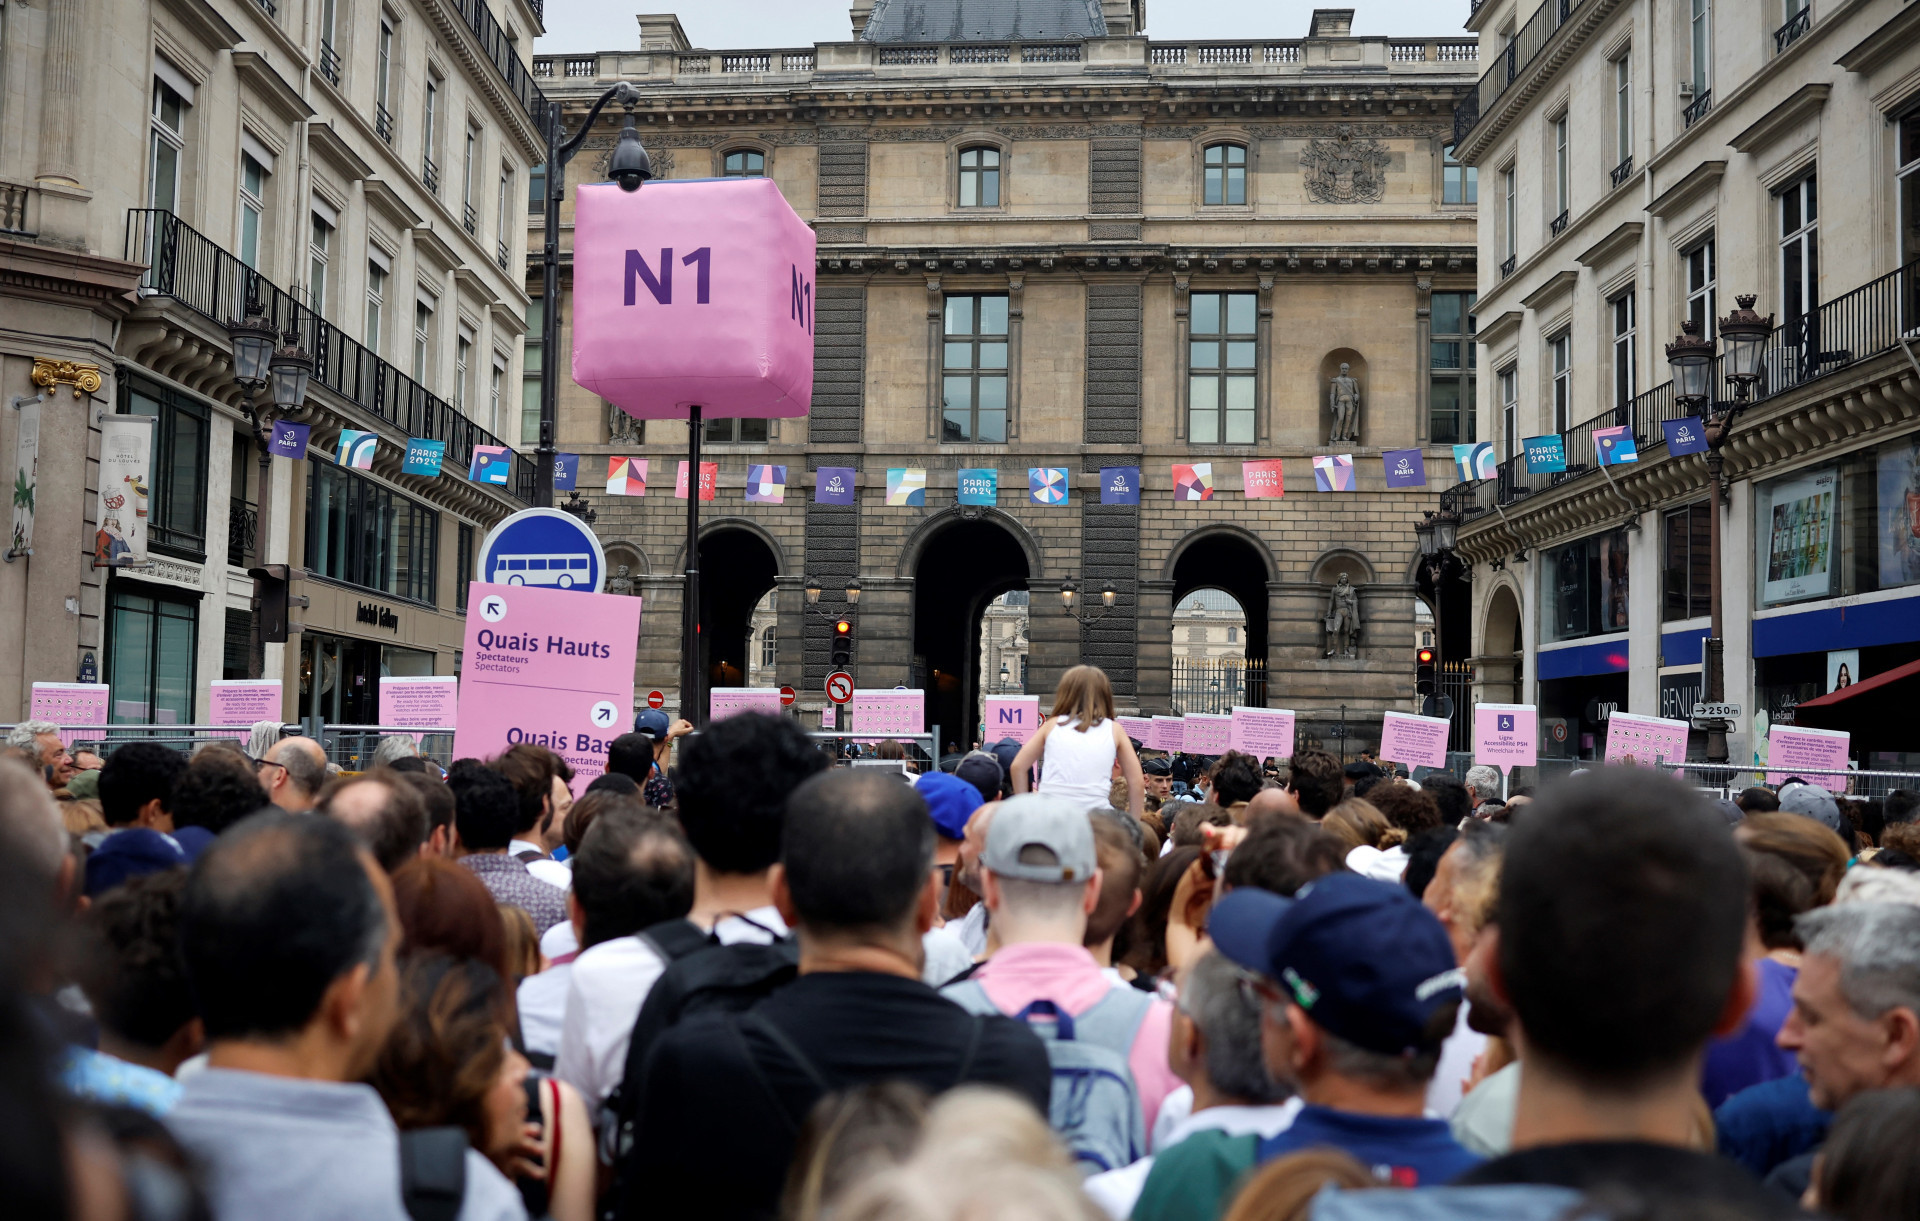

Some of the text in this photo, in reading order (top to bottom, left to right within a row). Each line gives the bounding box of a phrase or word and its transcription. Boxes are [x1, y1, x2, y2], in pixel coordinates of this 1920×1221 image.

[624, 247, 710, 306] N1
[792, 263, 811, 336] N1
[278, 439, 297, 448] PARIS
[1675, 435, 1696, 445] PARIS
[410, 448, 438, 458] PARIS
[1529, 445, 1558, 456] PARIS
[409, 456, 436, 466] 2024
[906, 458, 965, 469] PAVILLON
[1531, 455, 1559, 464] 2024
[1248, 470, 1277, 479] PARIS
[1394, 467, 1415, 476] PARIS
[682, 480, 710, 489] 224
[963, 478, 991, 487] PARIS
[1249, 479, 1278, 487] 2024
[1816, 475, 1833, 485] sisley
[963, 487, 991, 495] 2024
[477, 629, 610, 659] Quais Hauts
[476, 651, 529, 664] Spectateurs
[474, 662, 520, 674] Spectators
[1597, 701, 1618, 721] DIOR
[1709, 706, 1738, 715] 250m
[1000, 708, 1022, 724] N1
[507, 727, 568, 750] Quais
